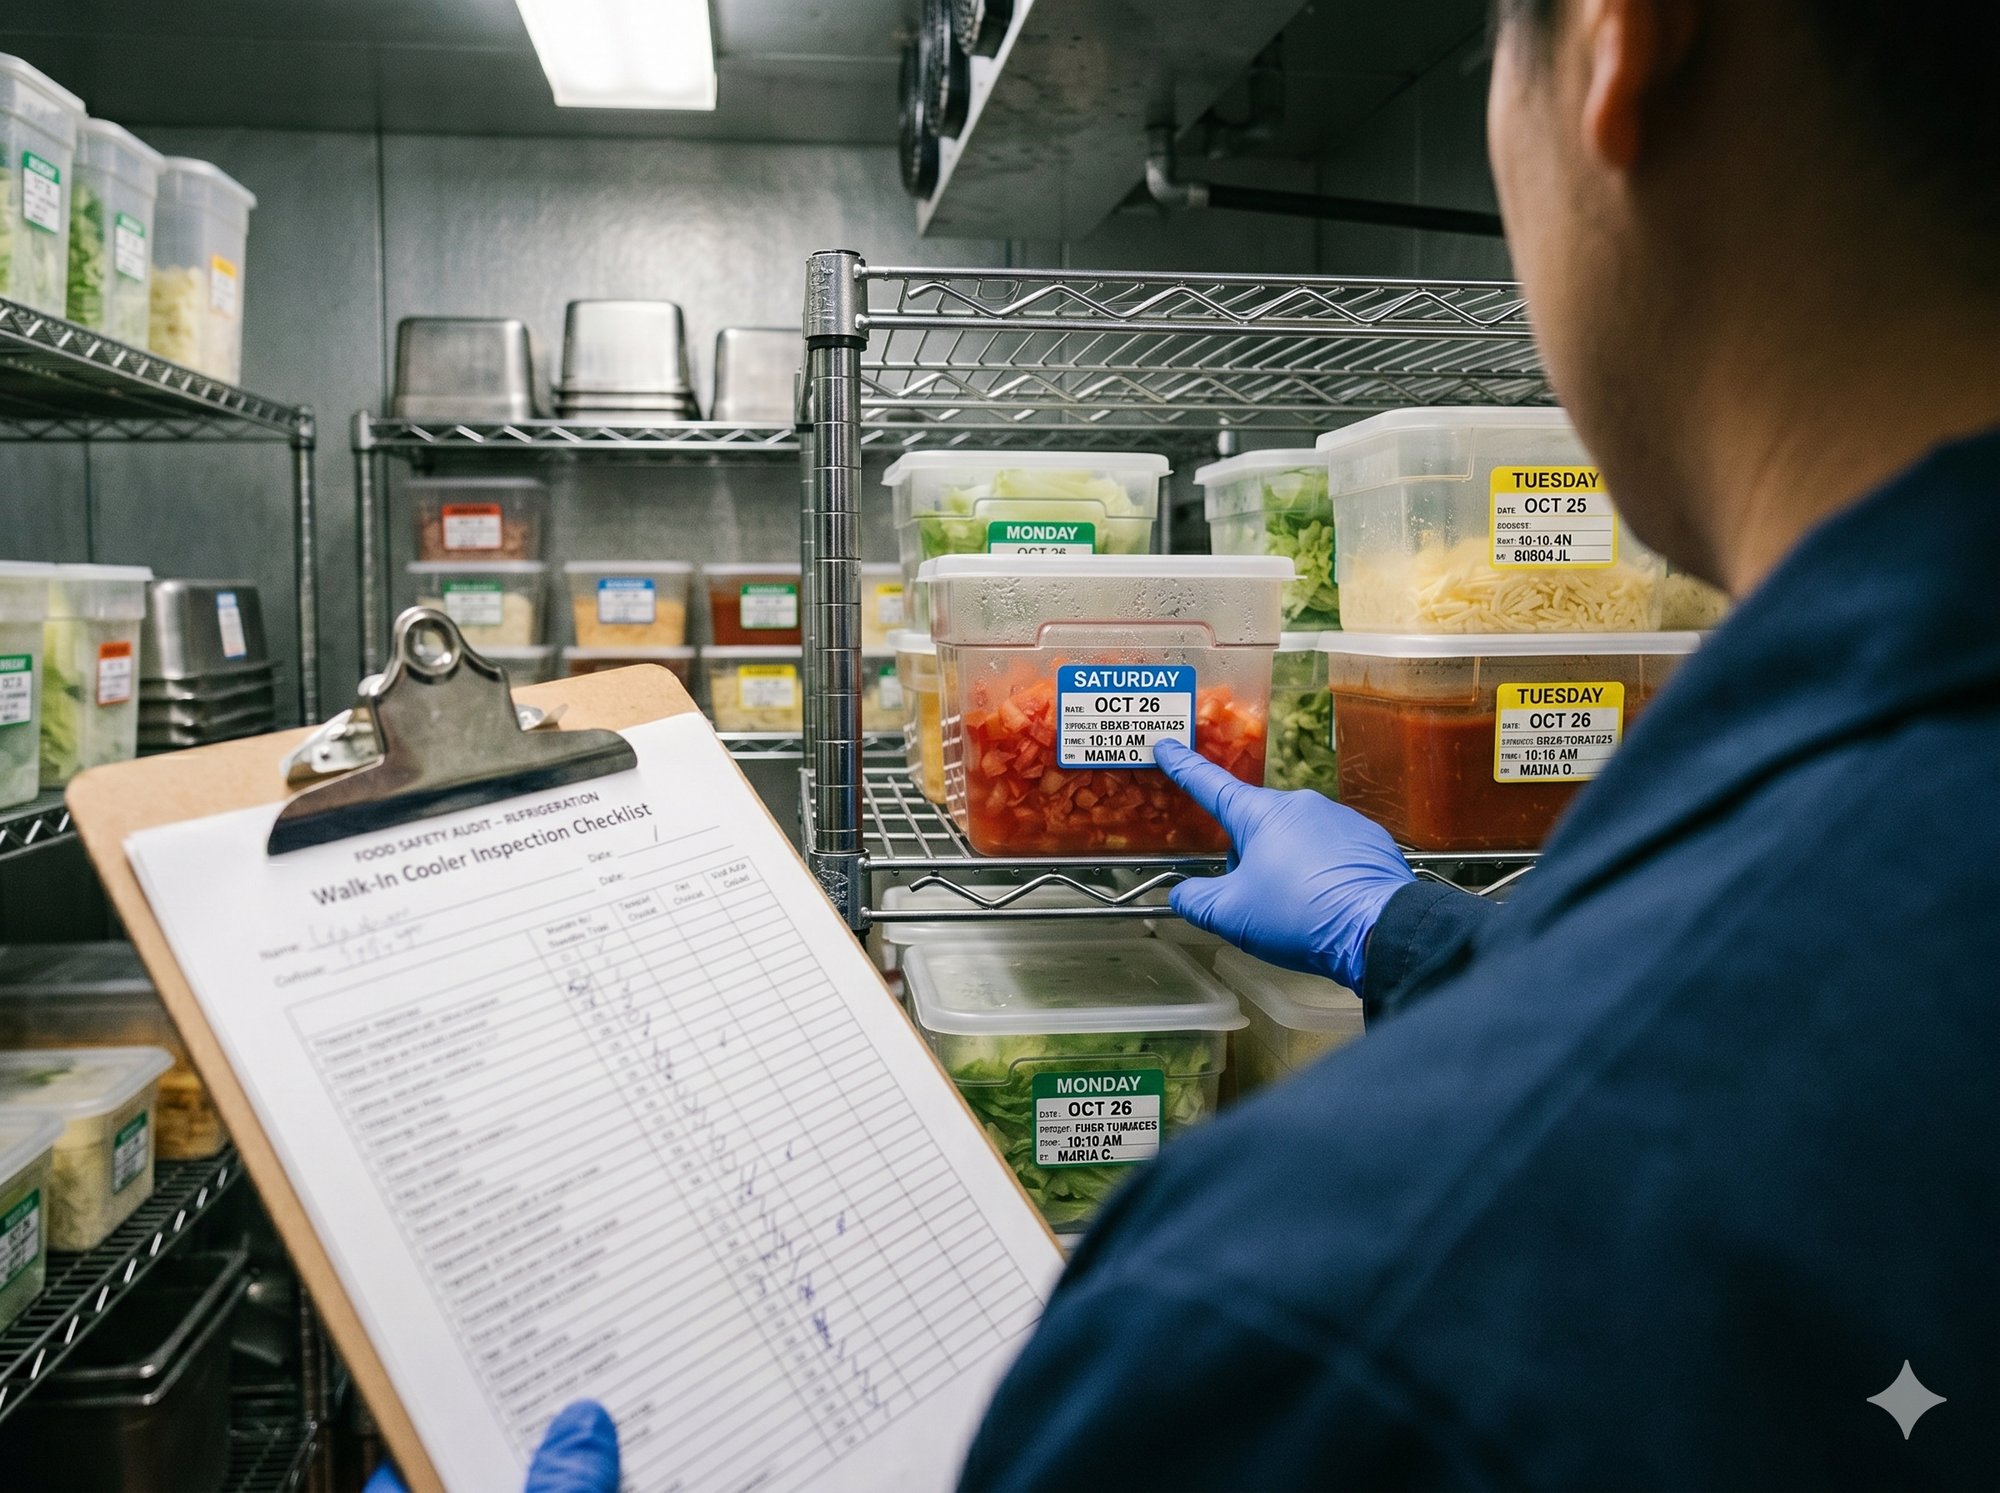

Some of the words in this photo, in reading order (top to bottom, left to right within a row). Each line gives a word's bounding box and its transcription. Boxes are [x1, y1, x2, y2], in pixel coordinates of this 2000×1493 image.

[1512, 472, 1600, 488] TUESDAY
[1524, 498, 1562, 513] OCT
[1566, 498, 1587, 513] 25
[1006, 526, 1078, 540] MONDAY
[1074, 670, 1180, 688] SATURDAY
[1517, 687, 1604, 704] TUESDAY
[1095, 697, 1134, 713] OCT
[1139, 697, 1160, 713] 26
[1530, 713, 1566, 729] OCT
[1571, 712, 1591, 728] 26
[1089, 735, 1122, 746] 10:10
[1126, 735, 1145, 746] AM
[1525, 749, 1556, 761] 10:16
[1559, 748, 1578, 760] AM
[354, 844, 396, 862] FOOD
[398, 830, 448, 852] SAFETY
[452, 819, 492, 838] AUDIT
[311, 871, 399, 908] Walk-In
[402, 855, 467, 882] Cooler
[470, 827, 570, 863] Inspection
[573, 802, 652, 835] Checklist
[598, 872, 624, 886] Date:
[1056, 1076, 1141, 1094] MONDAY
[1068, 1101, 1105, 1117] OCT
[1110, 1100, 1132, 1116] 26
[1067, 1136, 1099, 1148] 10:10
[1102, 1135, 1122, 1146] AM
[1101, 1149, 1114, 1160] C.
